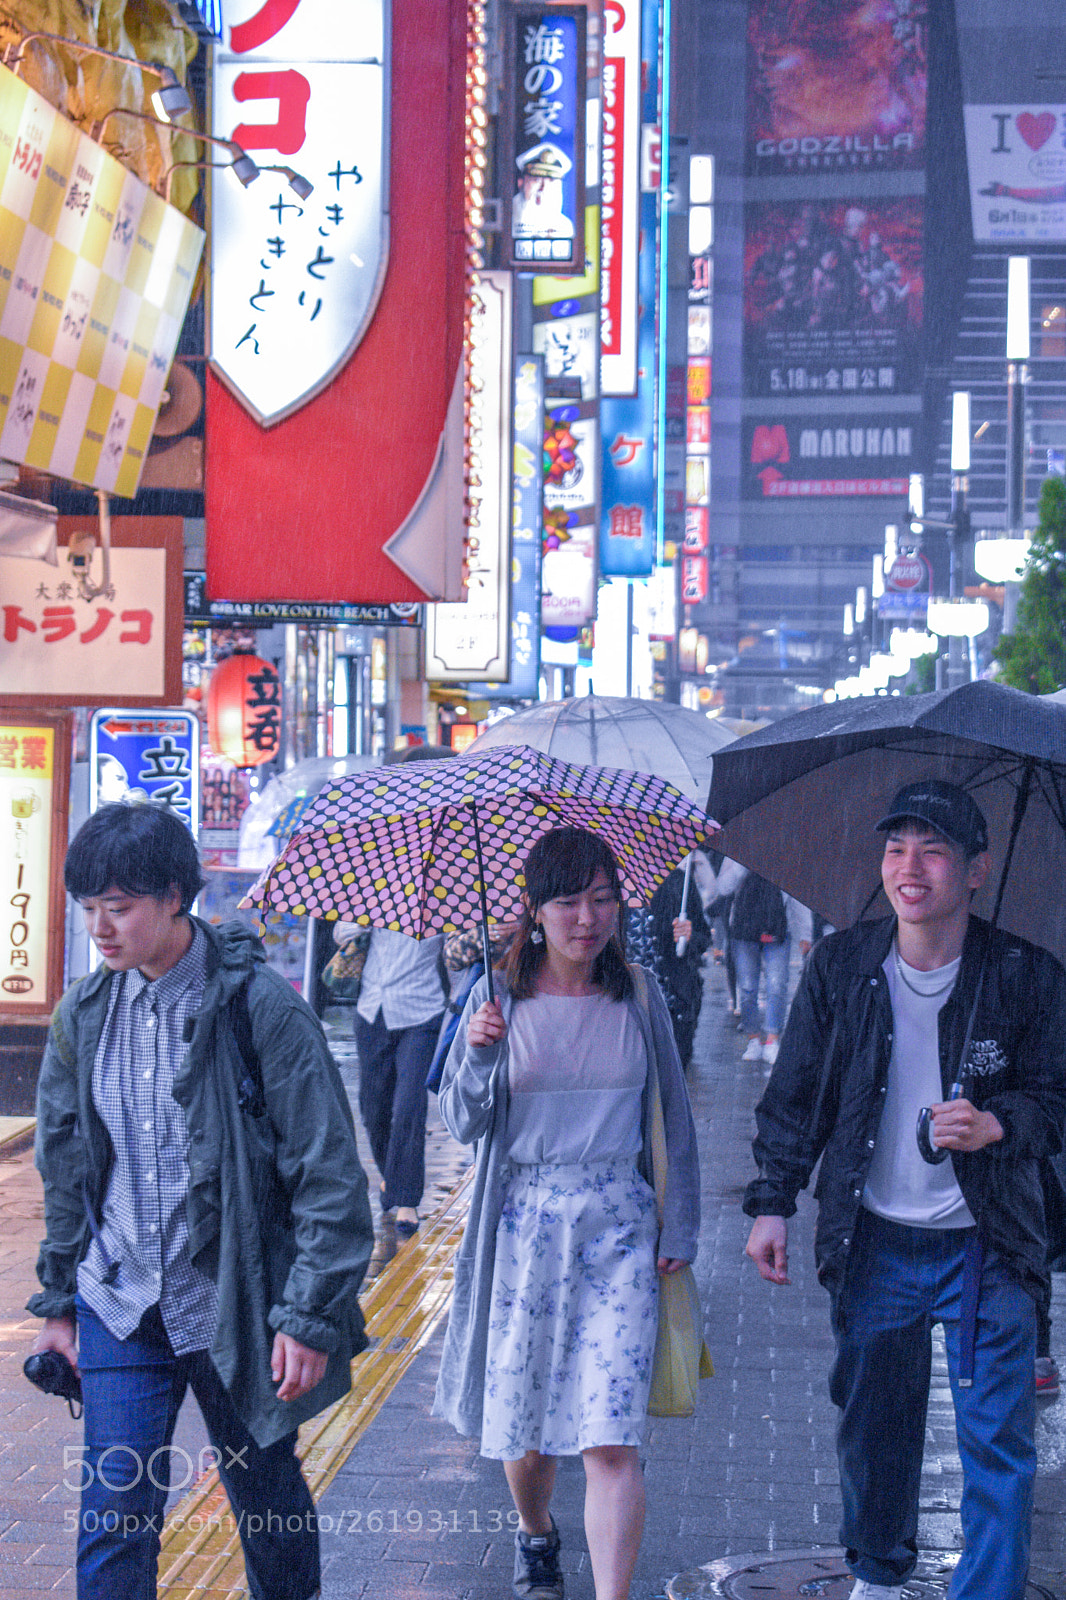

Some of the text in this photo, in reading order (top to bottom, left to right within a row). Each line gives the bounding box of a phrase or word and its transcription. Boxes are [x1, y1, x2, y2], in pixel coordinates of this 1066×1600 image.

[523, 24, 565, 138] 海の家
[755, 131, 915, 156] GODZILLA
[991, 113, 1011, 153] I
[299, 160, 363, 322] やきとり
[235, 193, 304, 355] やきとん
[800, 427, 912, 458] MARUHAN
[2, 604, 154, 645] トラノコ
[254, 603, 290, 617] LOVE
[289, 605, 313, 617] ON
[314, 606, 342, 618] THE
[343, 606, 389, 619] BEACH
